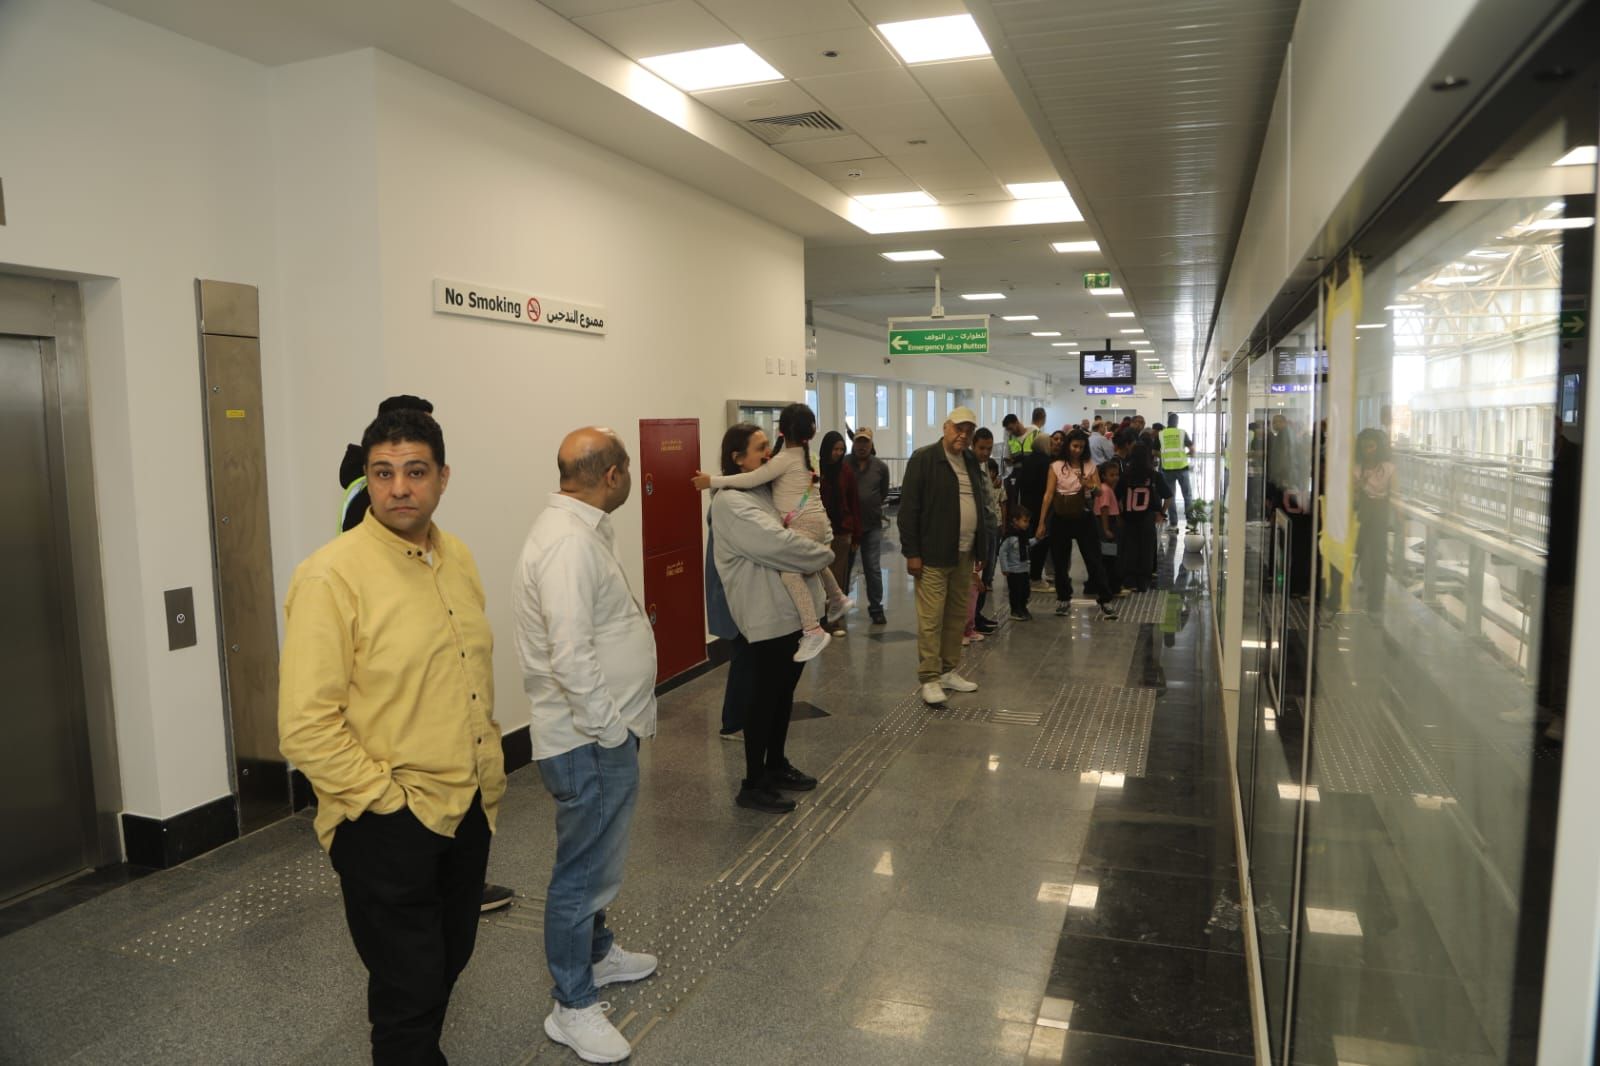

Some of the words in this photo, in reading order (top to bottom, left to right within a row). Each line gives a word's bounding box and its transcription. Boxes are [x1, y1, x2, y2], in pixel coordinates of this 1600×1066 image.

[445, 287, 463, 306] No
[469, 292, 521, 318] Smoking
[907, 343, 945, 353] Emergency
[945, 342, 962, 352] Stop
[962, 341, 987, 350] Button
[1094, 386, 1108, 394] Exit
[1126, 487, 1150, 512] 10
